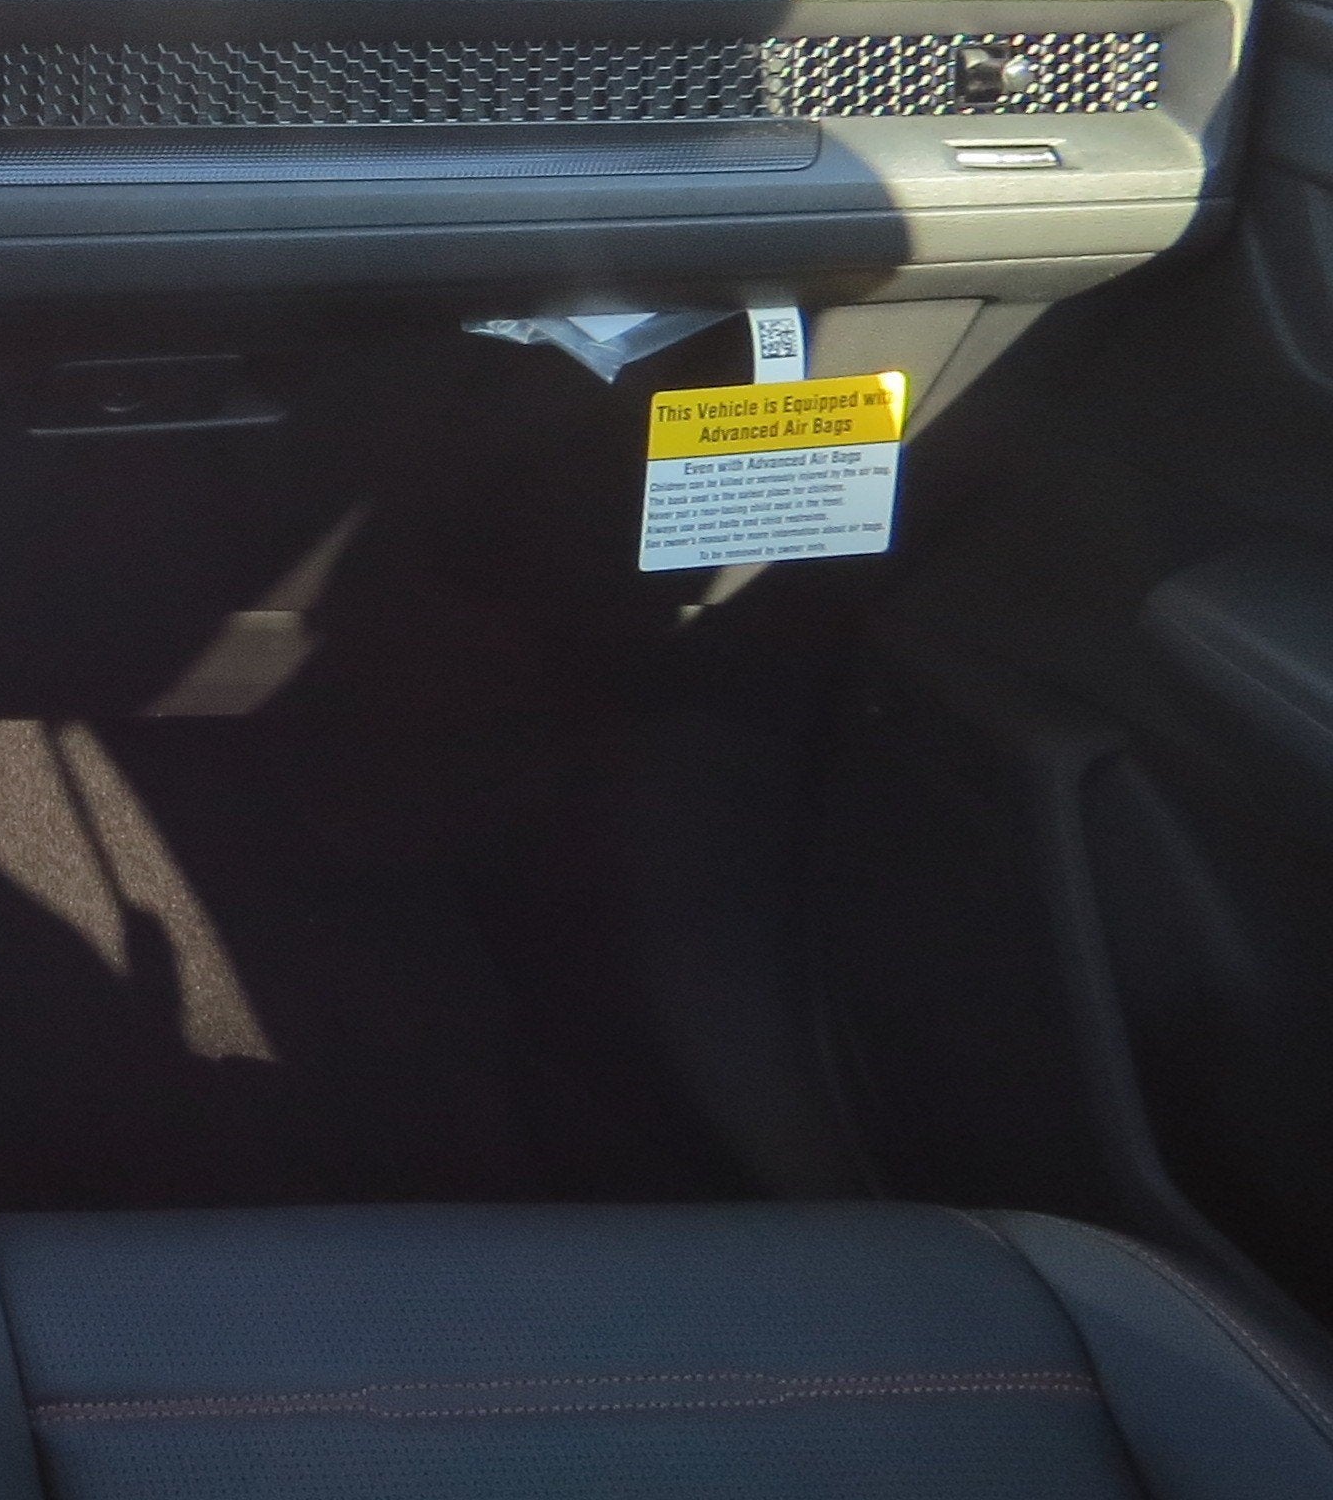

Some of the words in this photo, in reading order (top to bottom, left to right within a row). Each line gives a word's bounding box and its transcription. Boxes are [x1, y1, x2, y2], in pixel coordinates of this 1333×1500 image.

[656, 404, 692, 422] This
[697, 399, 759, 419] Vehicle
[764, 398, 778, 414] is
[783, 391, 859, 414] Equipped
[698, 420, 780, 443] Advanced
[783, 419, 808, 436] Air
[813, 417, 853, 436] Bags
